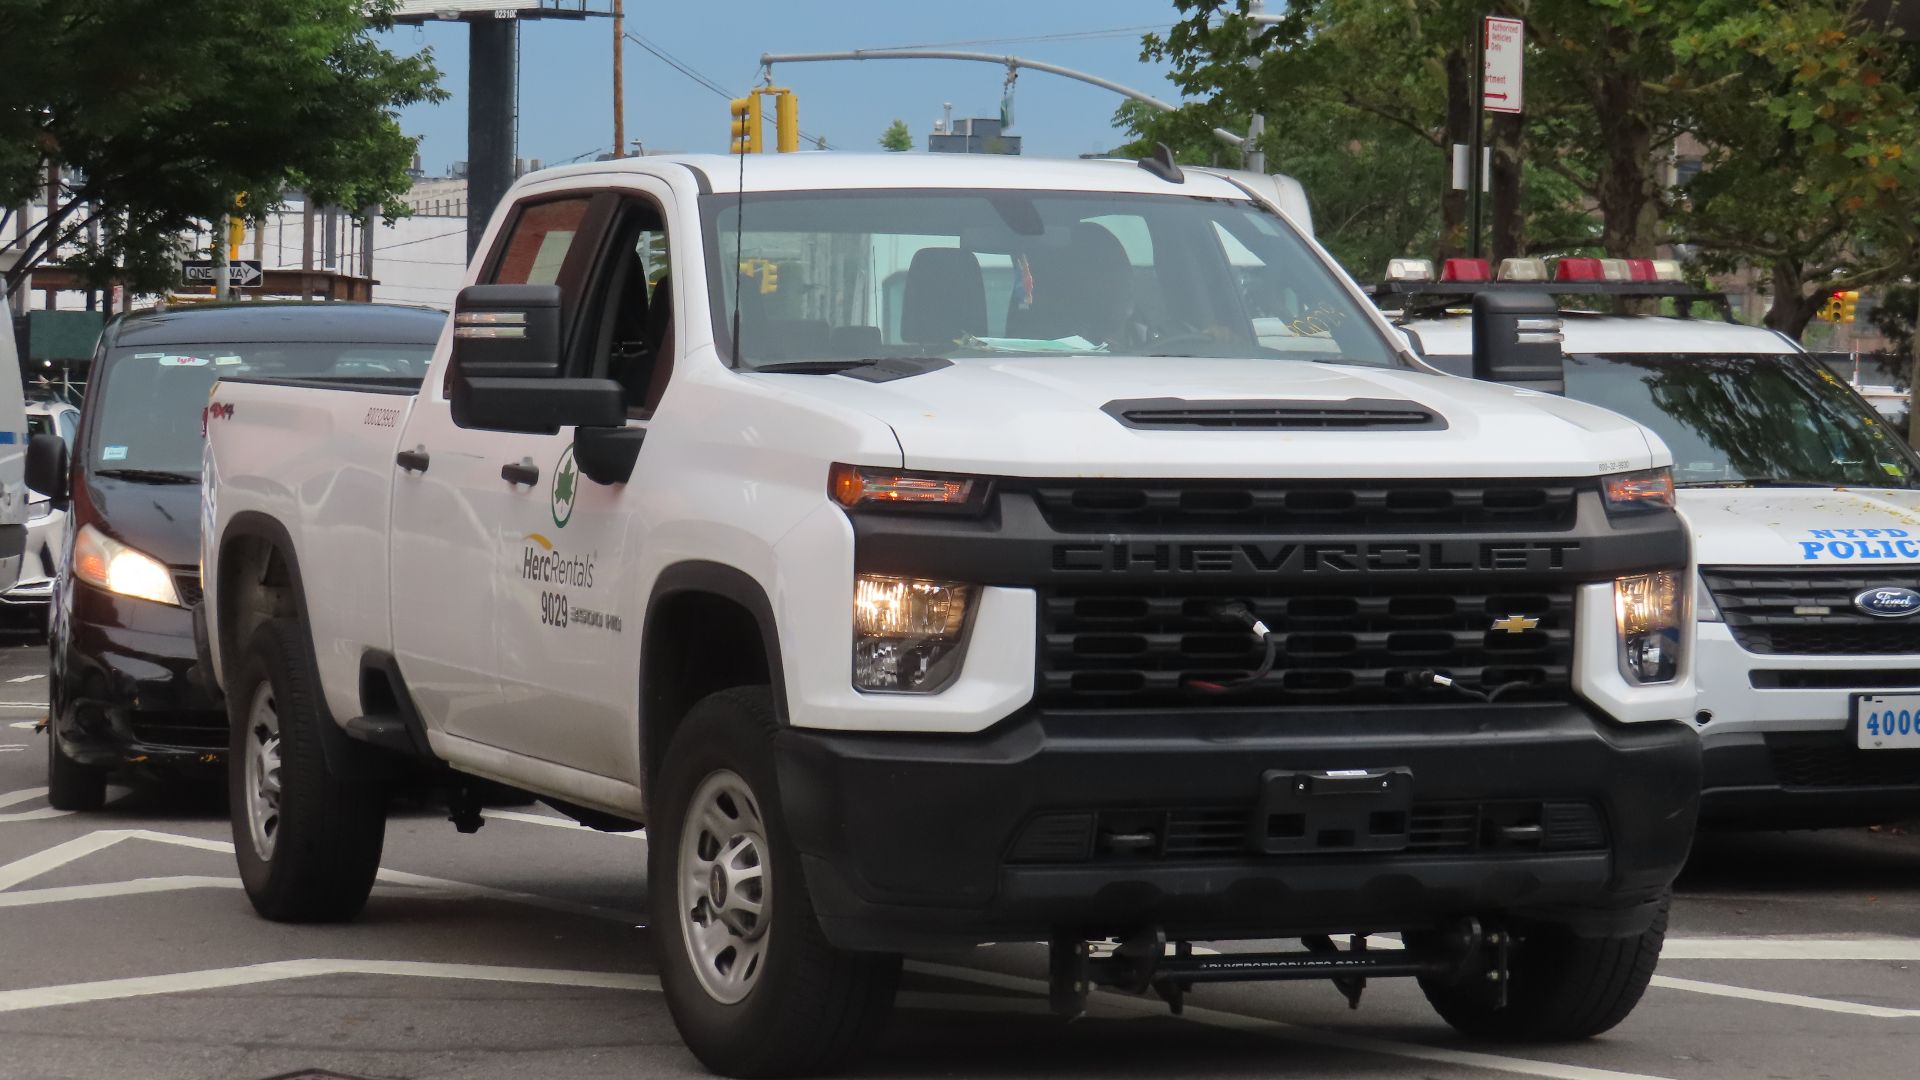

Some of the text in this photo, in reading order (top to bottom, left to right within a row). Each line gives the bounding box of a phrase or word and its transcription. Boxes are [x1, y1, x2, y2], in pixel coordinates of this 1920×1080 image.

[1492, 23, 1518, 33] Authorized
[1490, 42, 1502, 52] Only
[188, 267, 212, 279] ONE
[1807, 528, 1909, 539] NYPD
[1052, 541, 1580, 573] CHEVROLET
[1798, 540, 1920, 560] POLIC
[1873, 591, 1912, 608] Ford
[541, 591, 568, 629] 9029
